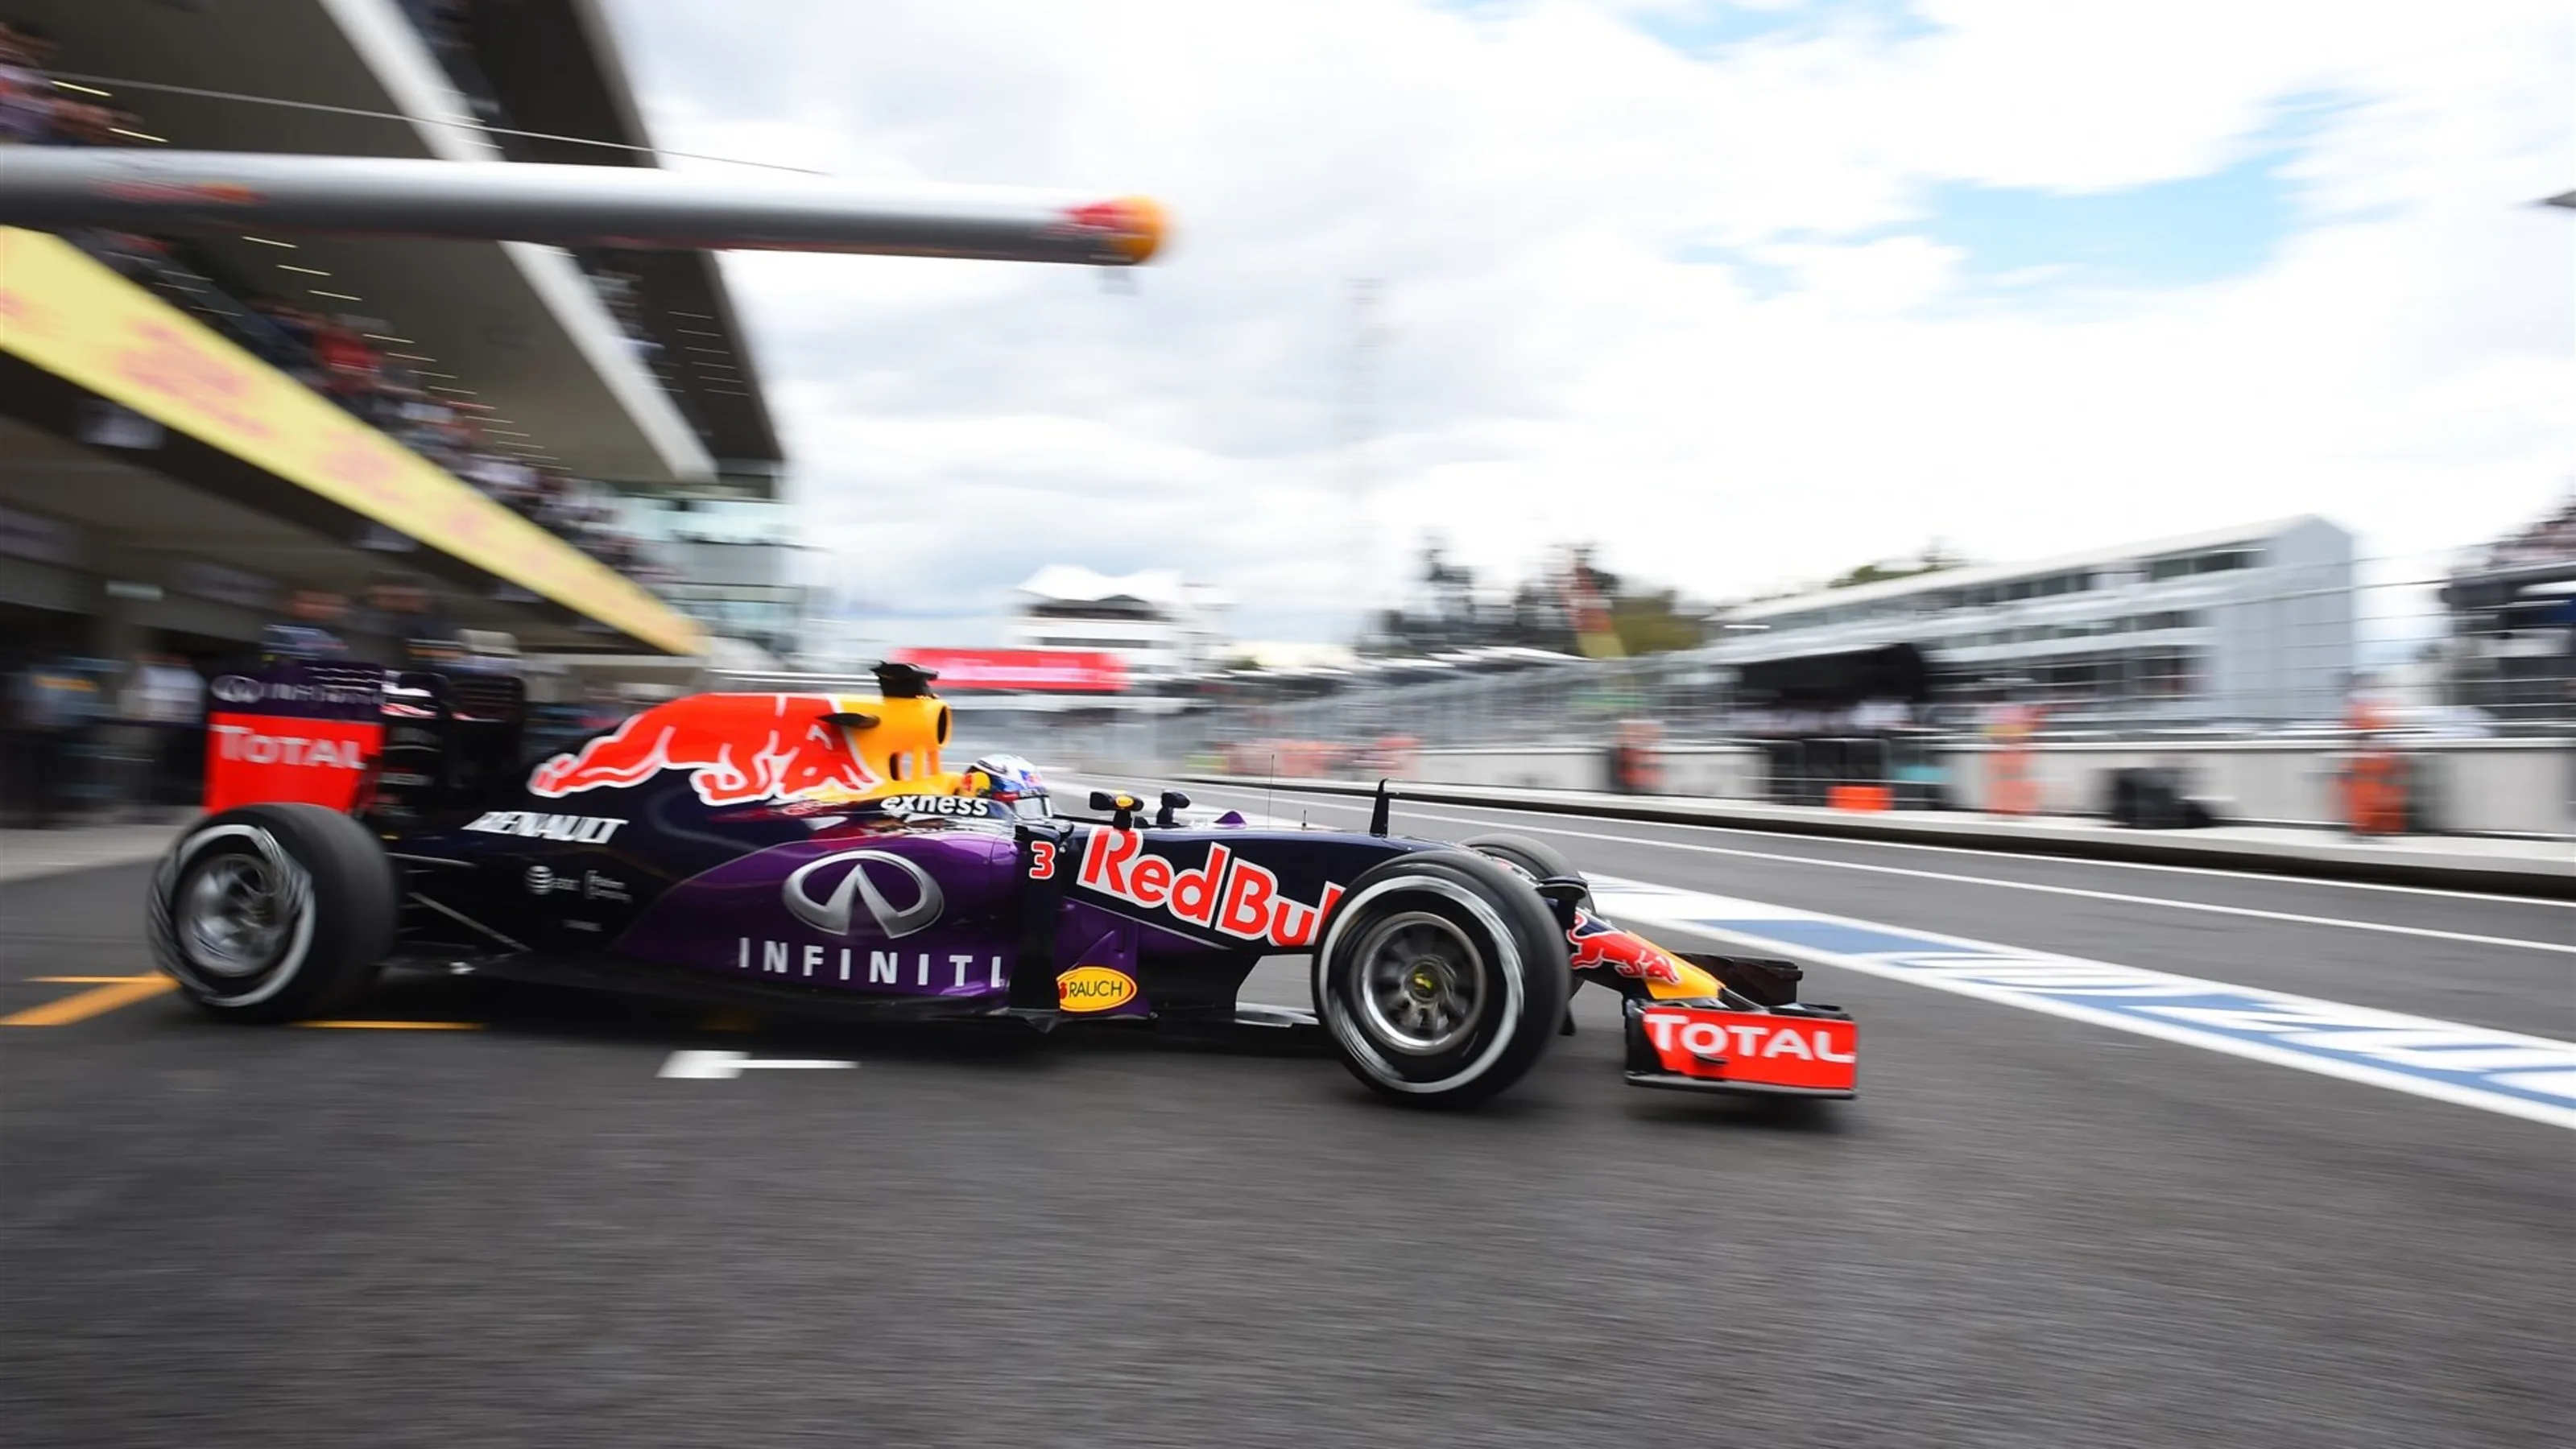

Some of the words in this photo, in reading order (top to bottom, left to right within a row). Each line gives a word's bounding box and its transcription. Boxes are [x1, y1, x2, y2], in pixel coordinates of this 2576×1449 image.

[209, 724, 368, 770] TOTAL
[881, 792, 990, 817] exness
[461, 810, 629, 844] RENAULT
[1030, 841, 1056, 879] 3
[1081, 827, 1228, 925] Red
[738, 936, 1002, 989] INFINITI
[1068, 980, 1123, 998] RAUCH
[1644, 1013, 1856, 1063] TOTAL
